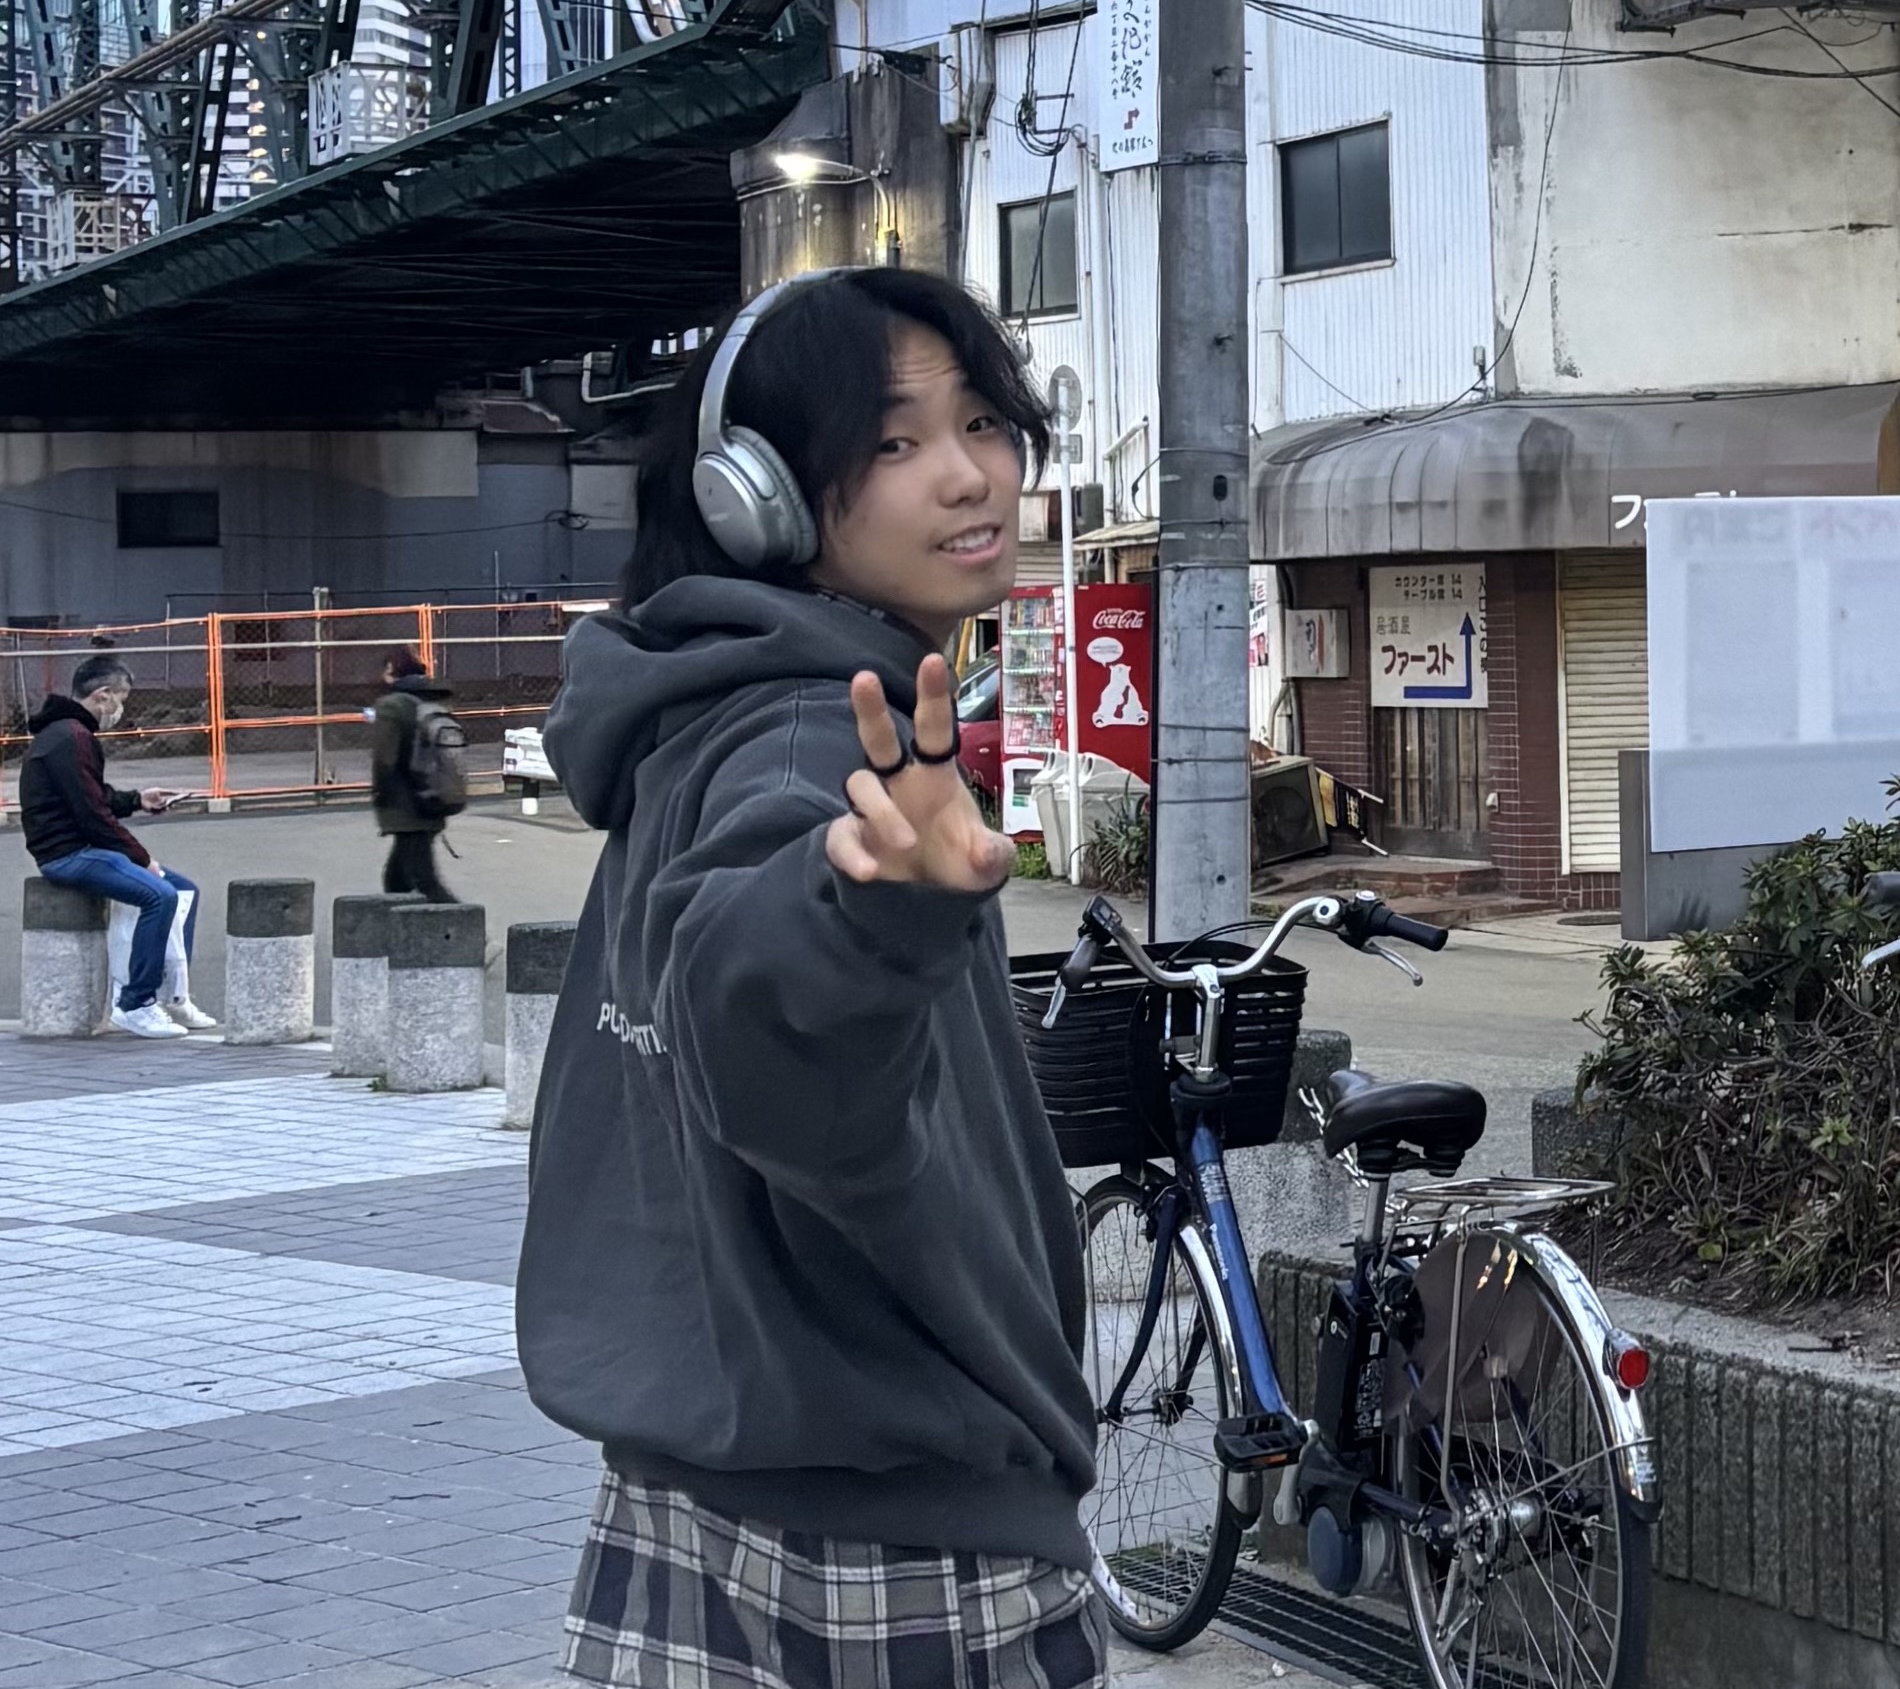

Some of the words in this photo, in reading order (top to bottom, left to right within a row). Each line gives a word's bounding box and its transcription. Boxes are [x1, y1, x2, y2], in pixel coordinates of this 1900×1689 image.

[1376, 615, 1411, 636] 居酒屋
[1381, 642, 1455, 676] ファースト
